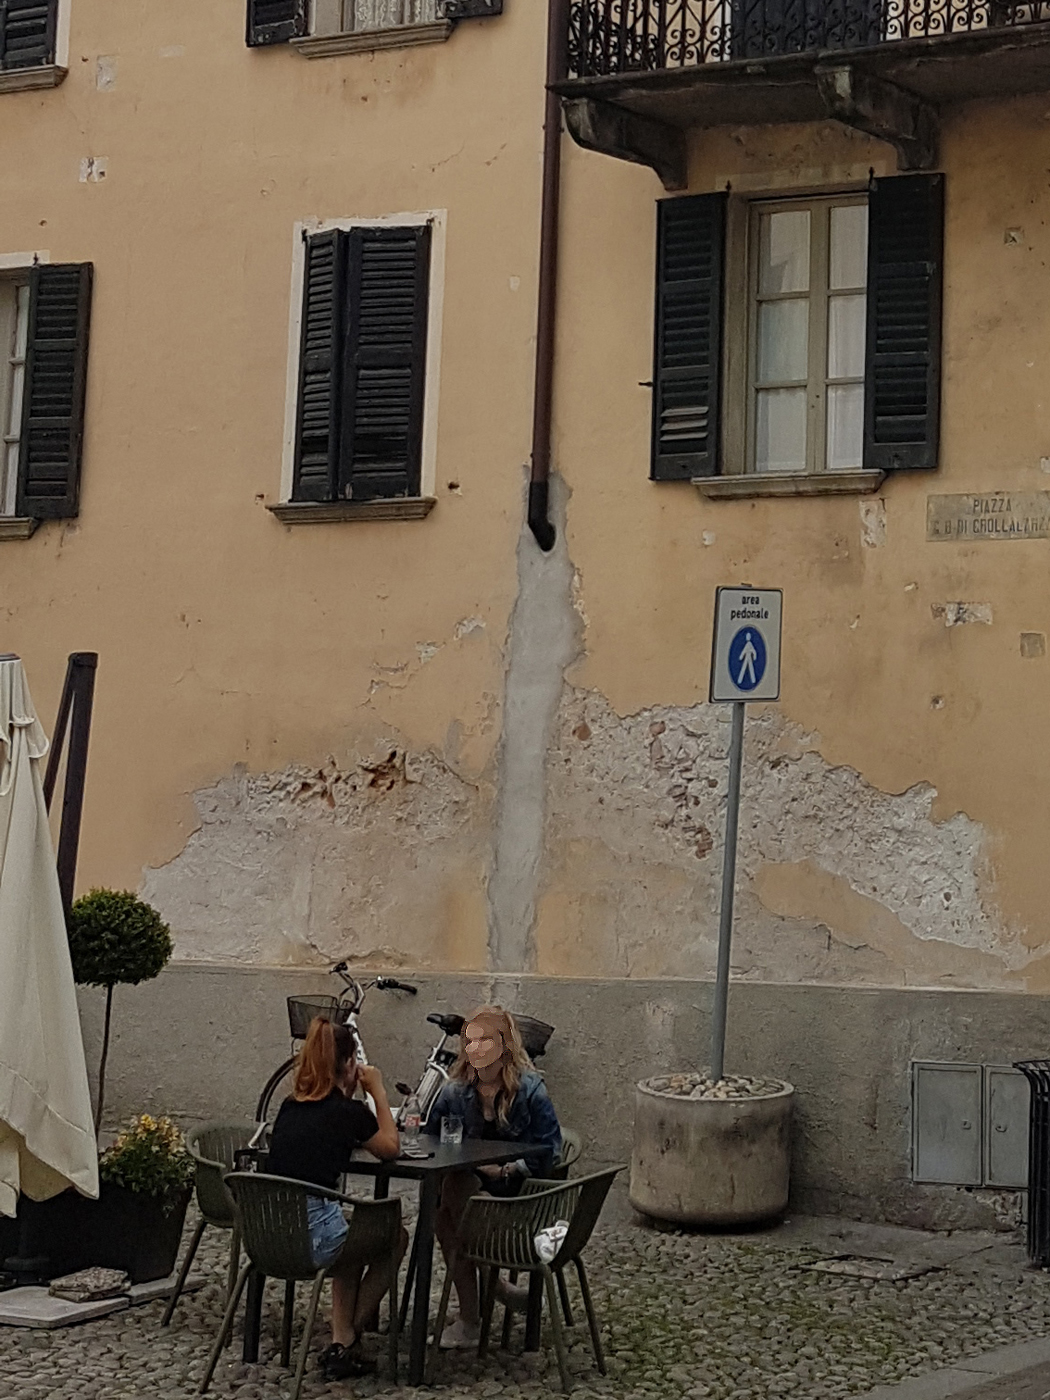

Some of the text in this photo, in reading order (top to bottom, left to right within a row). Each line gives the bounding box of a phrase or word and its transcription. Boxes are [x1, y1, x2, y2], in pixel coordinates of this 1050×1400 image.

[973, 498, 1012, 514] PIAZZA
[957, 519, 968, 534] DI
[741, 596, 760, 605] area
[730, 608, 769, 620] pedonale
